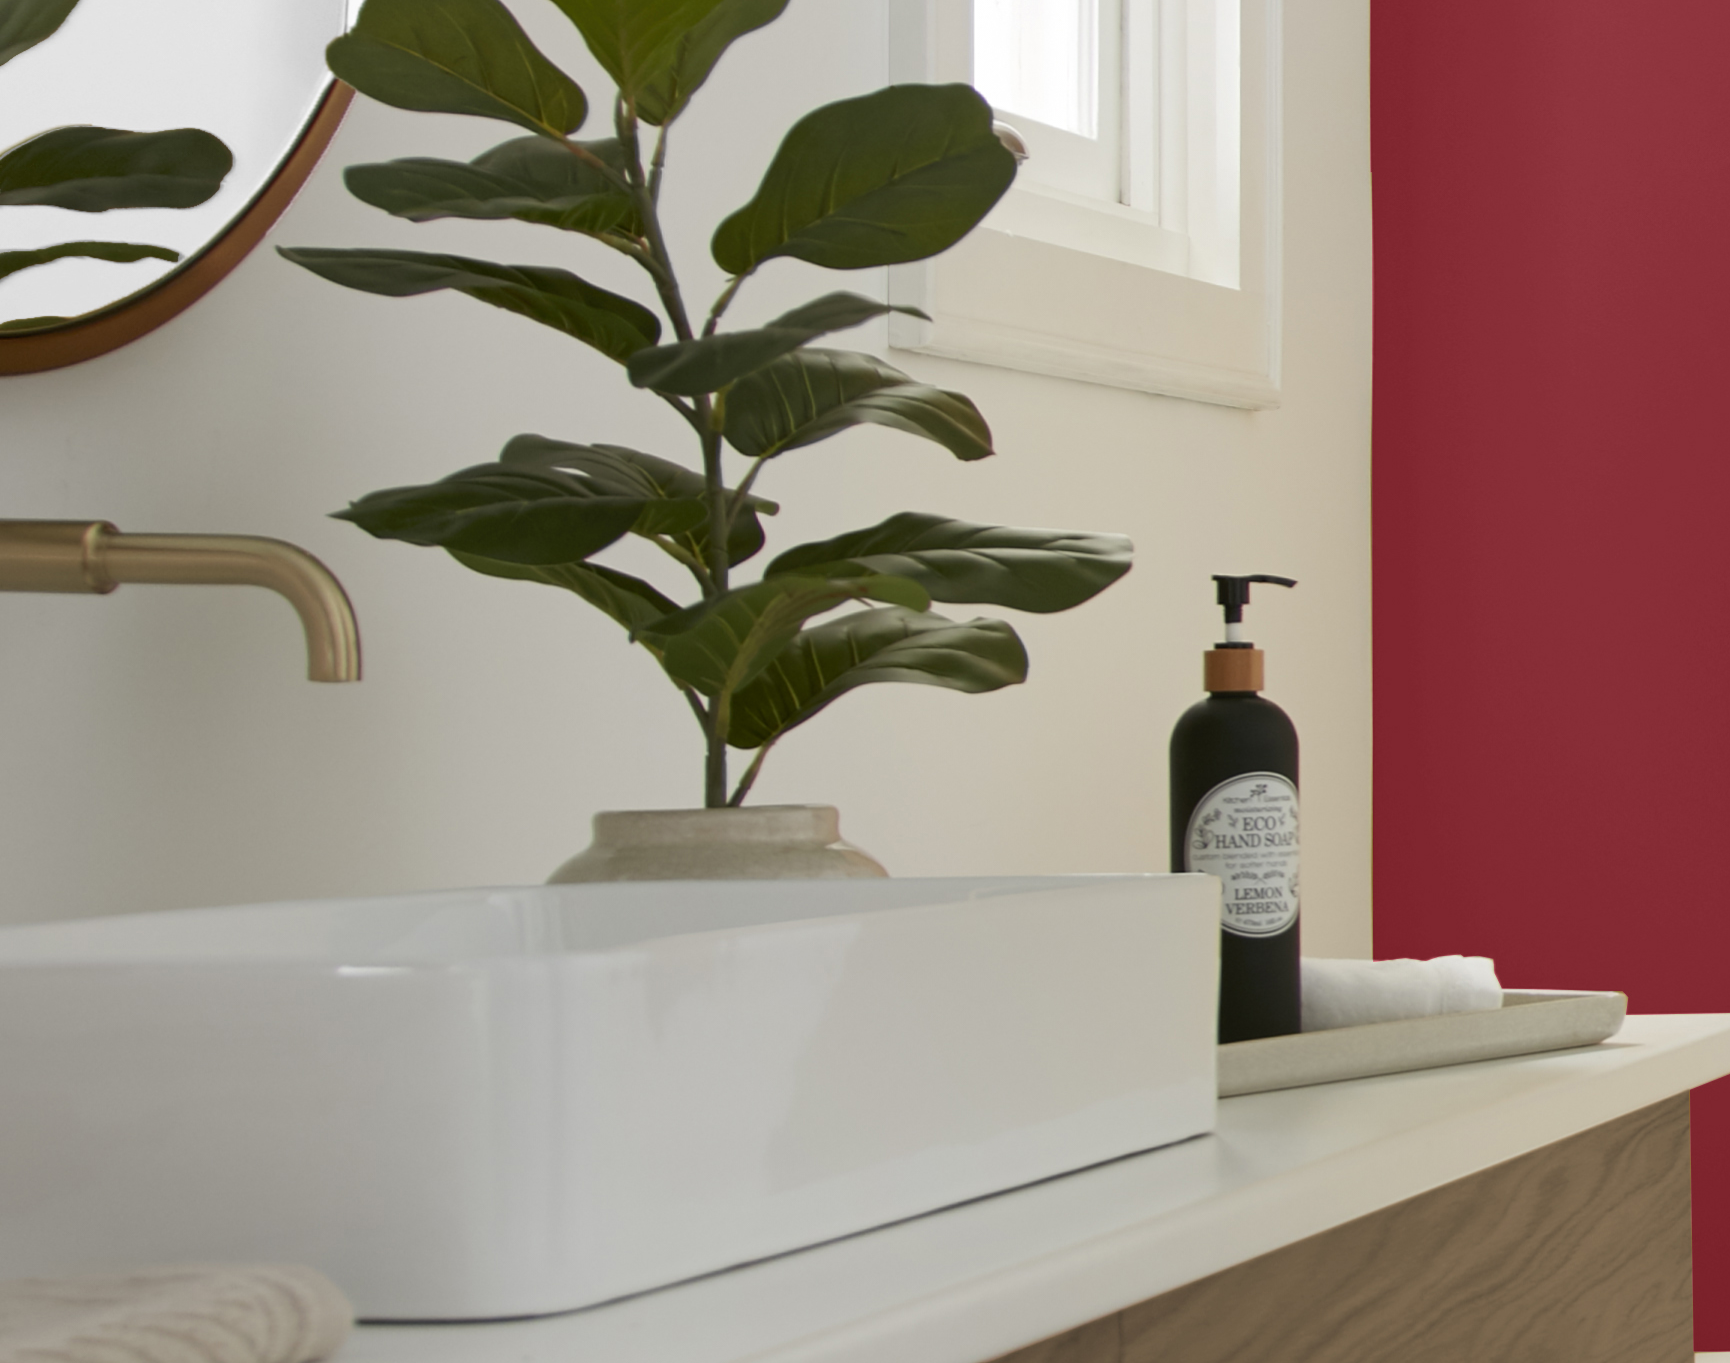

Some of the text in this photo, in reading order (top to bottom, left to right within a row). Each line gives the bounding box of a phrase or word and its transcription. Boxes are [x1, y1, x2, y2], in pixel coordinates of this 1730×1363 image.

[1242, 815, 1276, 832] ECO
[1215, 832, 1295, 849] HAND SOAP
[1234, 887, 1283, 901] LEMON
[1225, 900, 1290, 916] VERBENA
